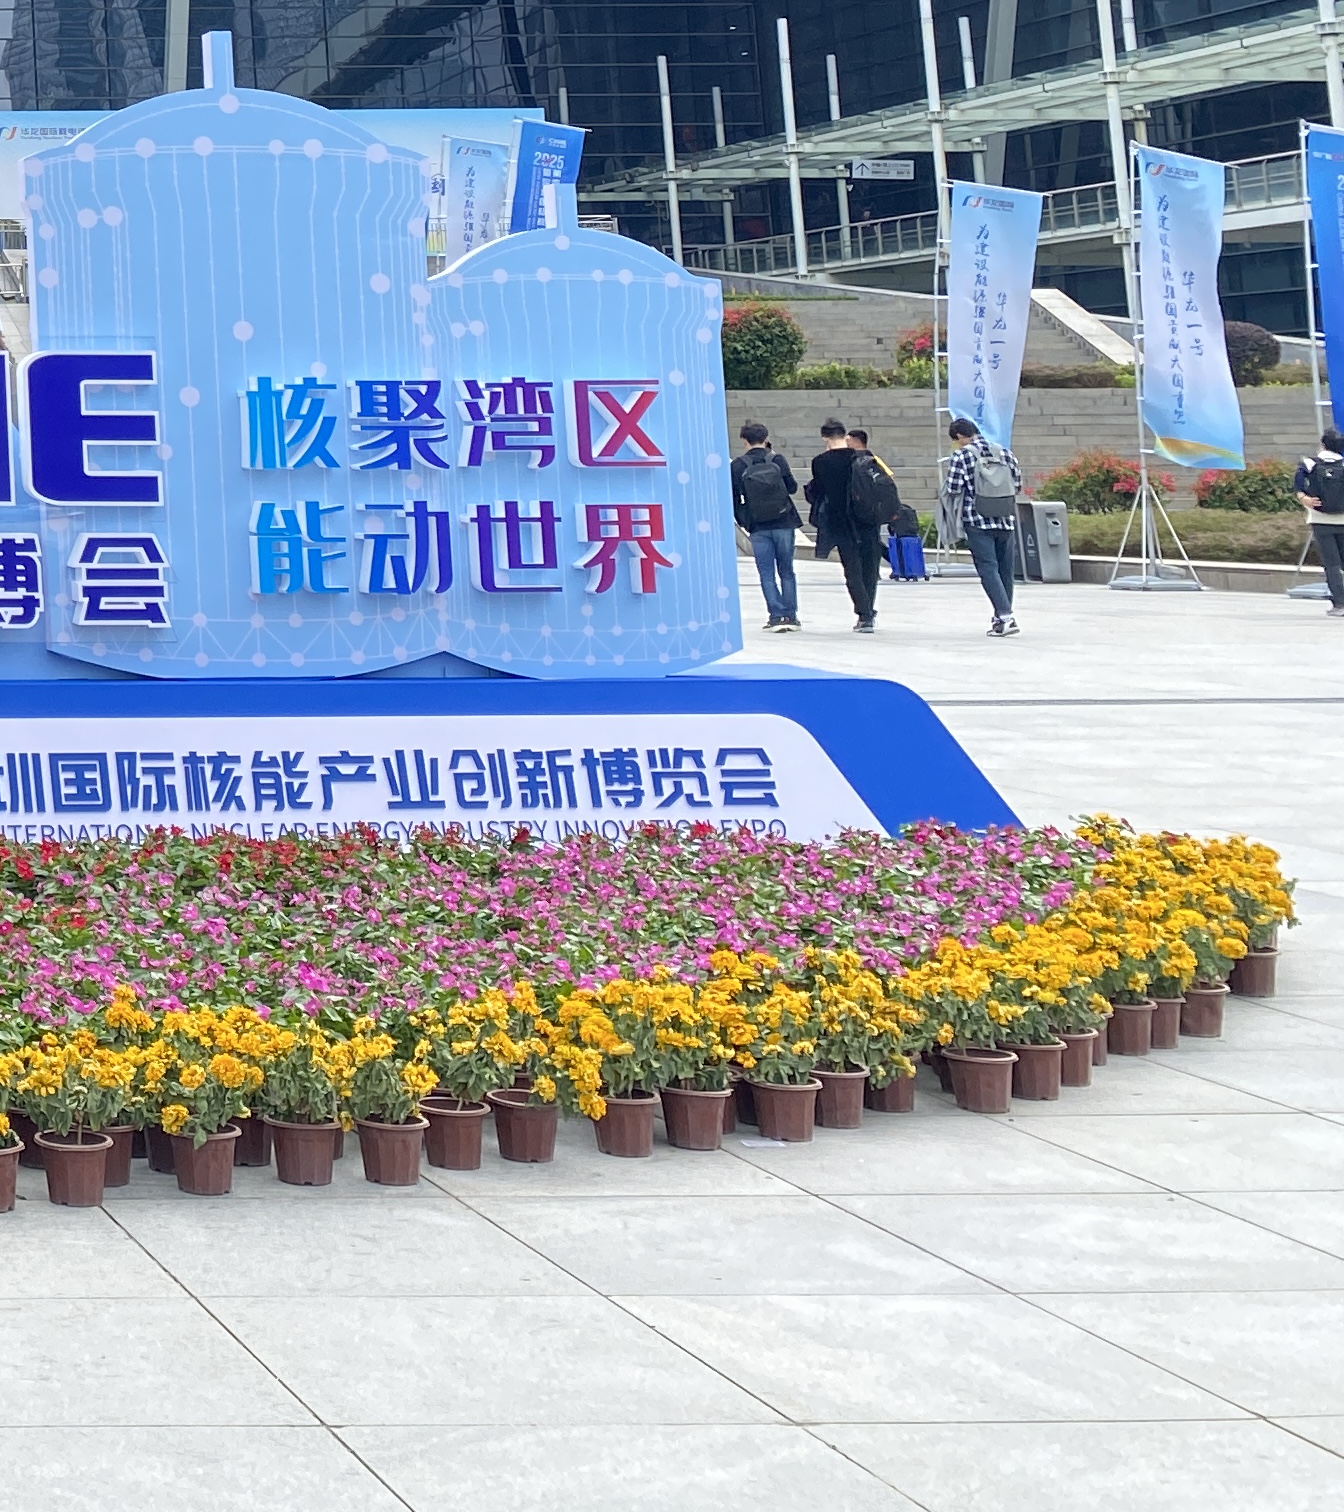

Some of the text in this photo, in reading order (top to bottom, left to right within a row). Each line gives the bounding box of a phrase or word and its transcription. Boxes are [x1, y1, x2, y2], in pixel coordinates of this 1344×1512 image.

[533, 152, 564, 169] 2025
[240, 376, 668, 470] 核聚湾区
[248, 500, 675, 595] 能动世界
